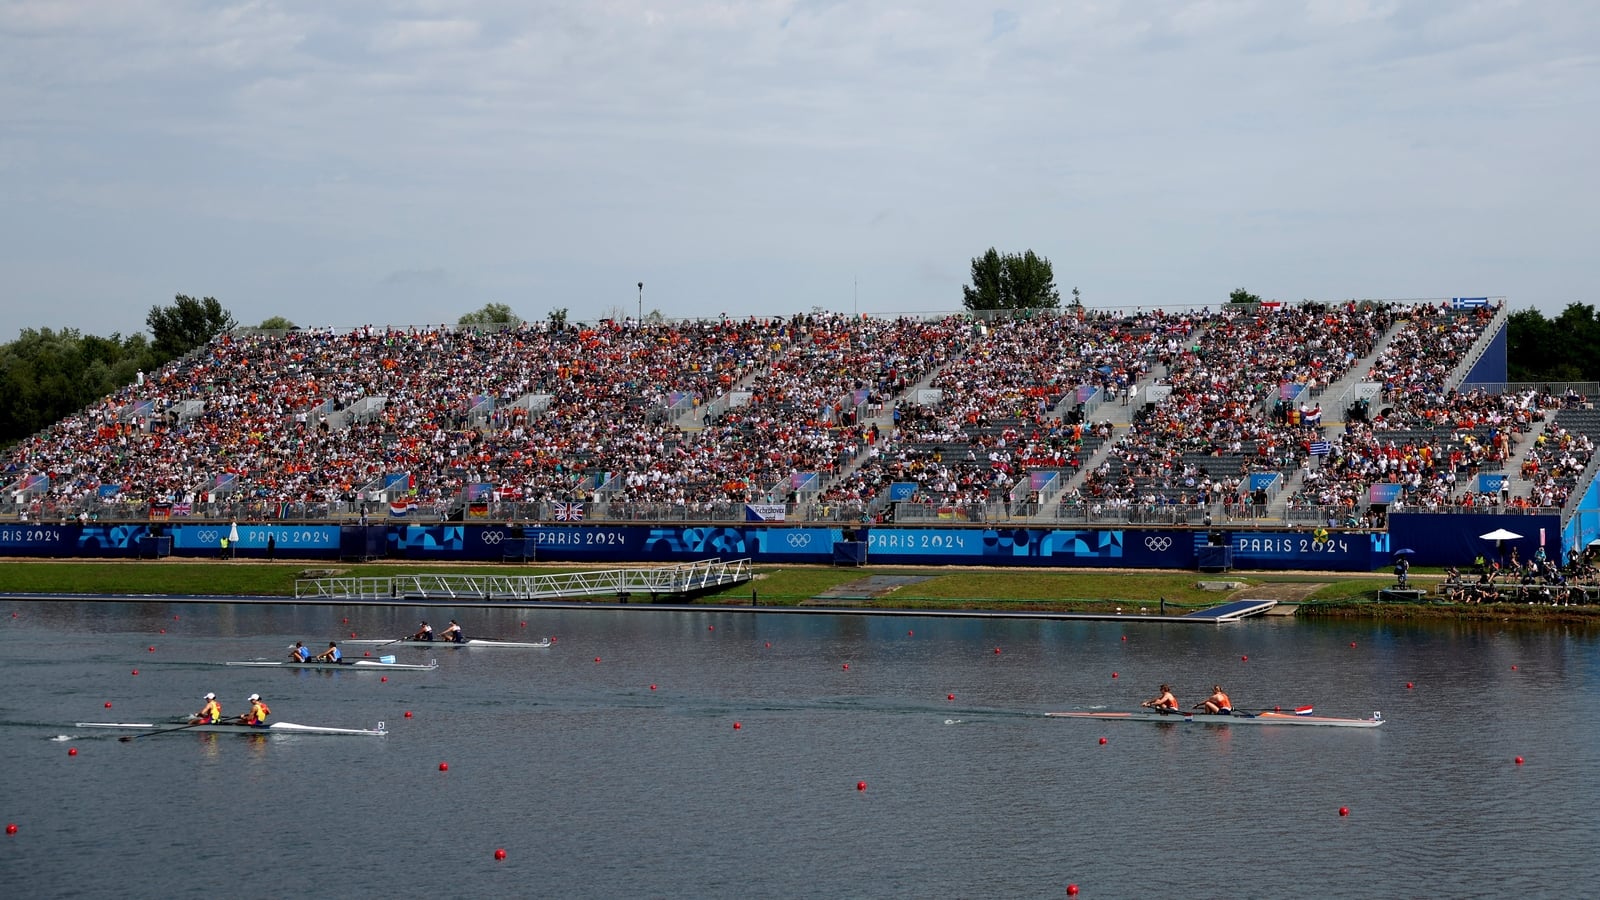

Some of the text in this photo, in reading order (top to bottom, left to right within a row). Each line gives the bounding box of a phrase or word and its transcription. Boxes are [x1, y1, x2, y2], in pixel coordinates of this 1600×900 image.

[26, 530, 60, 541] 2024
[293, 531, 329, 543] 2024
[586, 532, 625, 544] 2024
[921, 535, 964, 548] 2024
[1299, 539, 1347, 552] 2024
